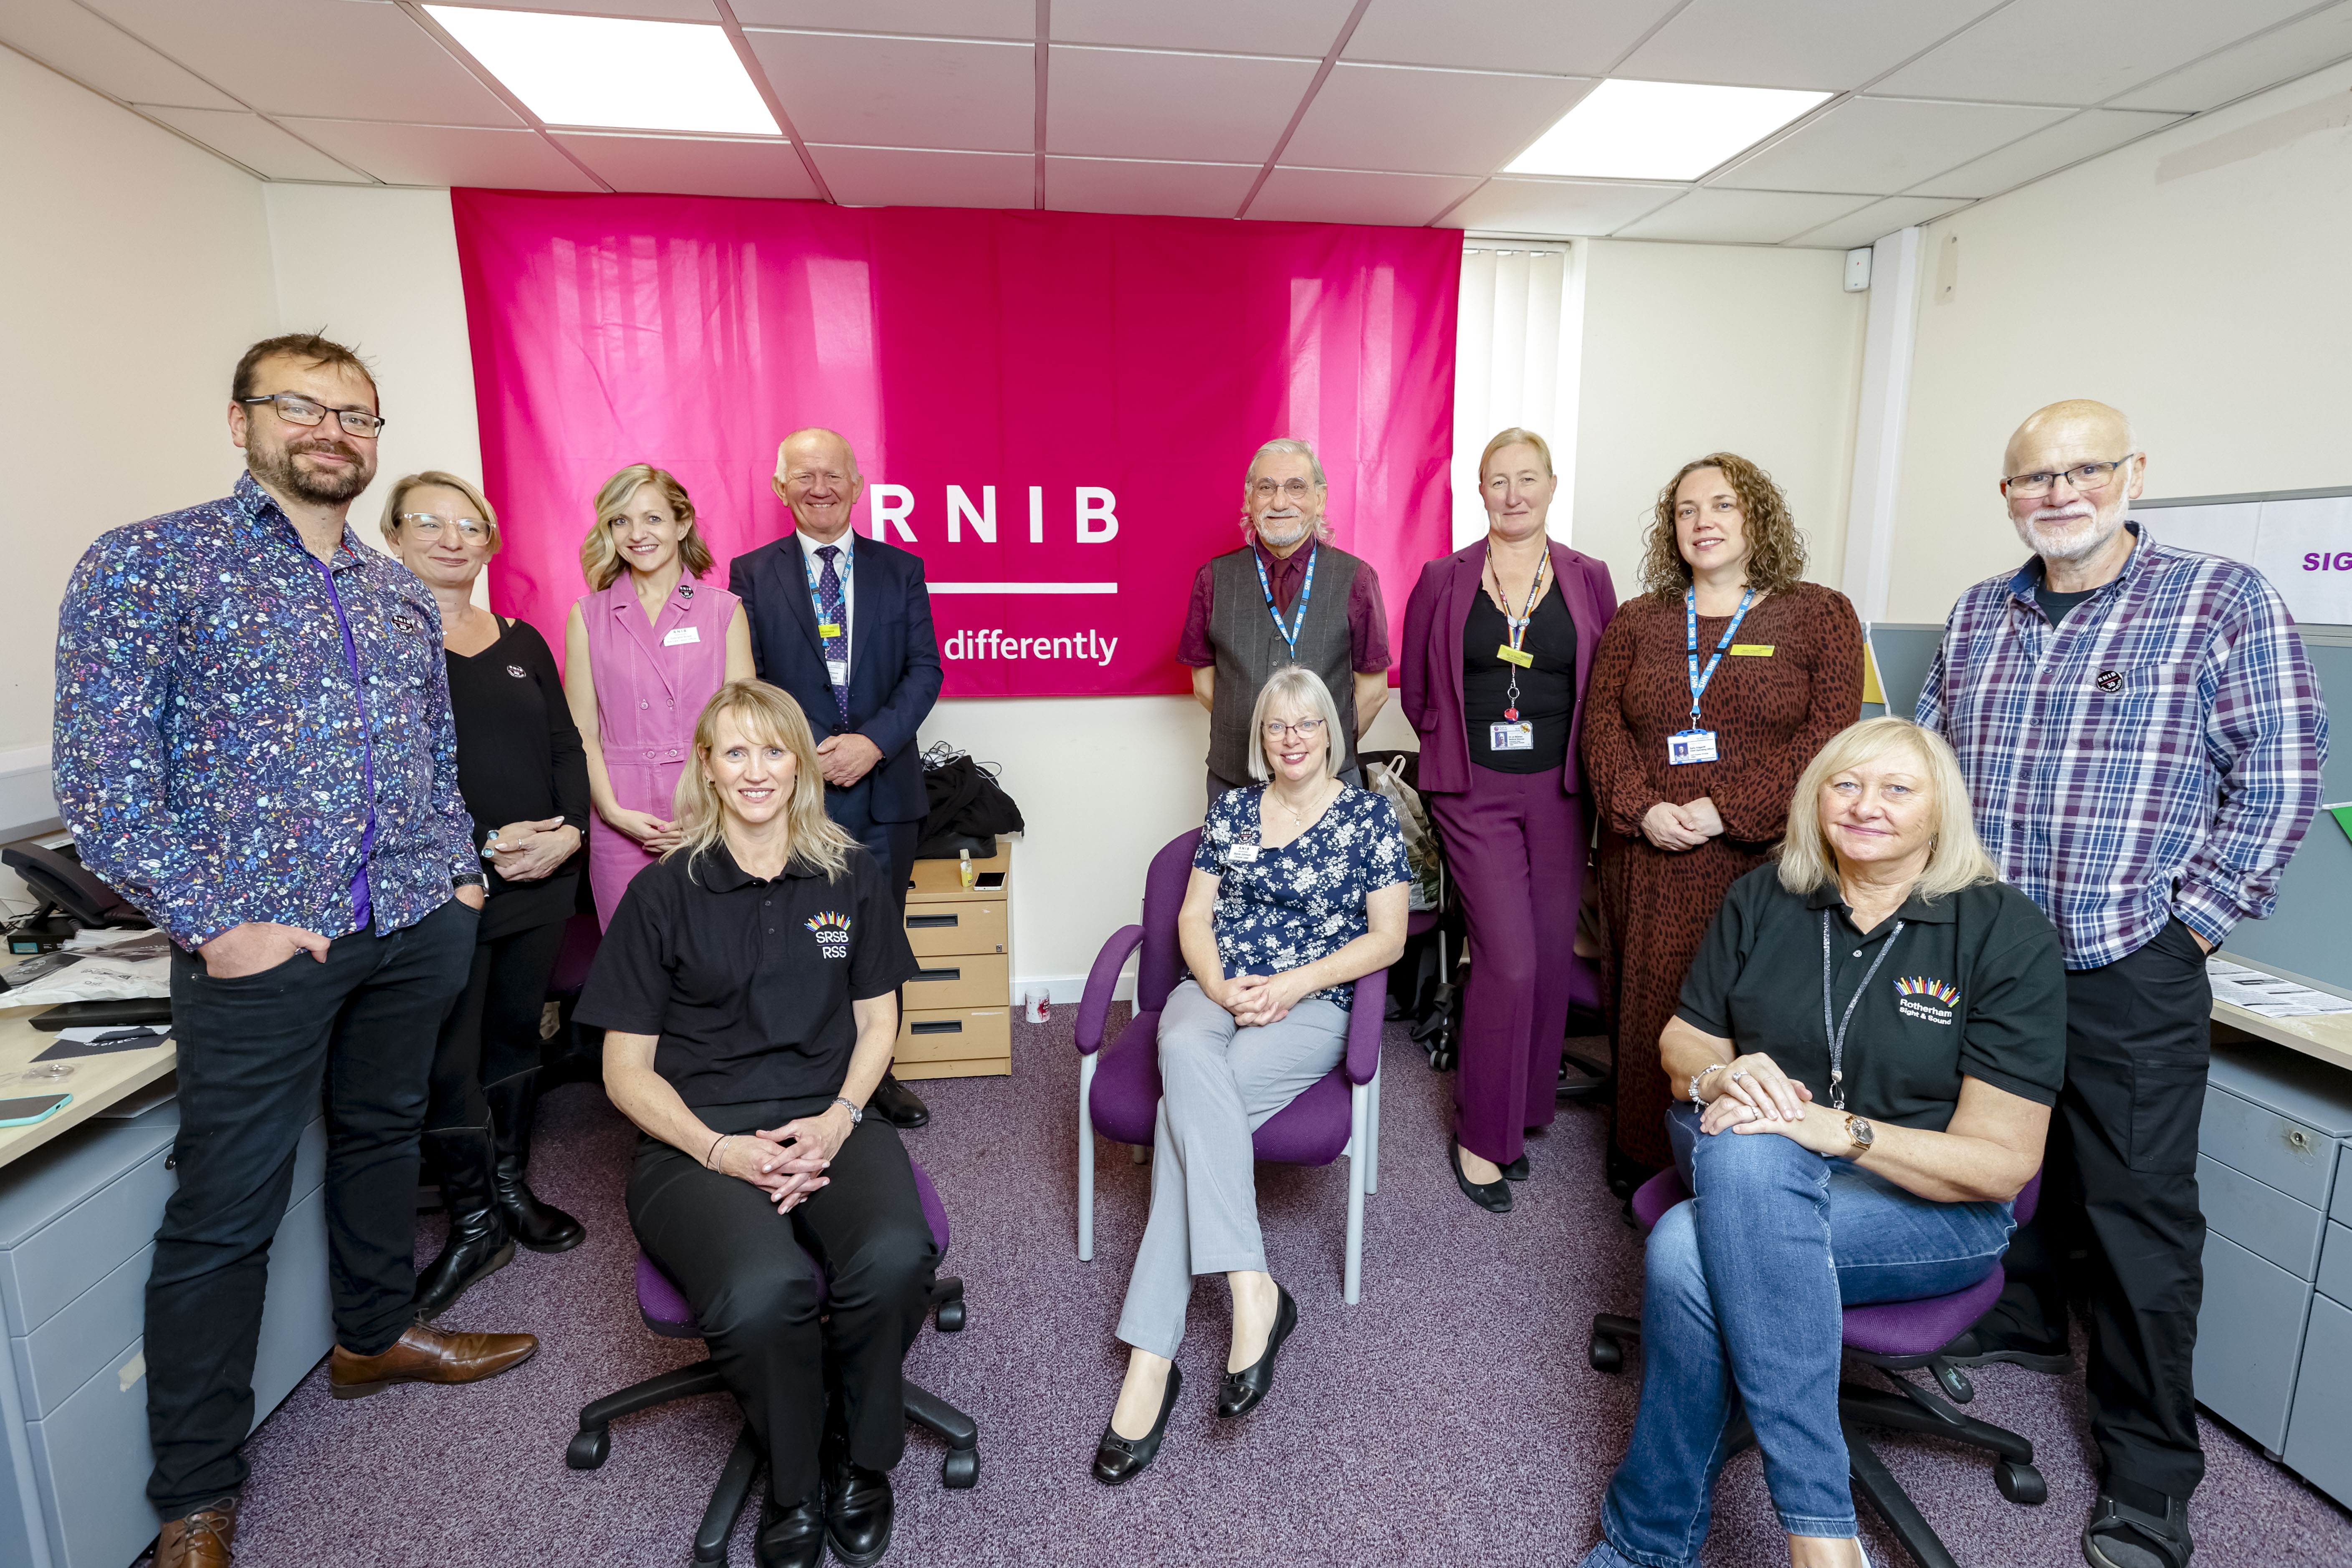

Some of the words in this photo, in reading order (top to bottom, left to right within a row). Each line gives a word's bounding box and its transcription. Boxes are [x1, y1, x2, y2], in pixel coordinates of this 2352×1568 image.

[870, 484, 1119, 544] RNIB
[2302, 552, 2352, 571] SIG
[1742, 594, 1752, 606] NHS
[1274, 614, 1283, 625] NHS
[1735, 608, 1745, 620] NHS
[394, 616, 411, 625] RNIB
[1280, 627, 1289, 639] NHS
[1727, 623, 1737, 635] NHS
[944, 629, 1118, 666] differently
[1706, 660, 1717, 671] NHS
[1698, 675, 1708, 688] NHS
[2097, 672, 2117, 683] RNIB
[1399, 811, 1408, 822] nd
[815, 931, 849, 943] SRSB
[822, 946, 847, 959] RSS
[1900, 998, 1952, 1017] Rotherham
[1899, 1007, 1920, 1018] Sight
[1927, 1015, 1952, 1025] Sound
